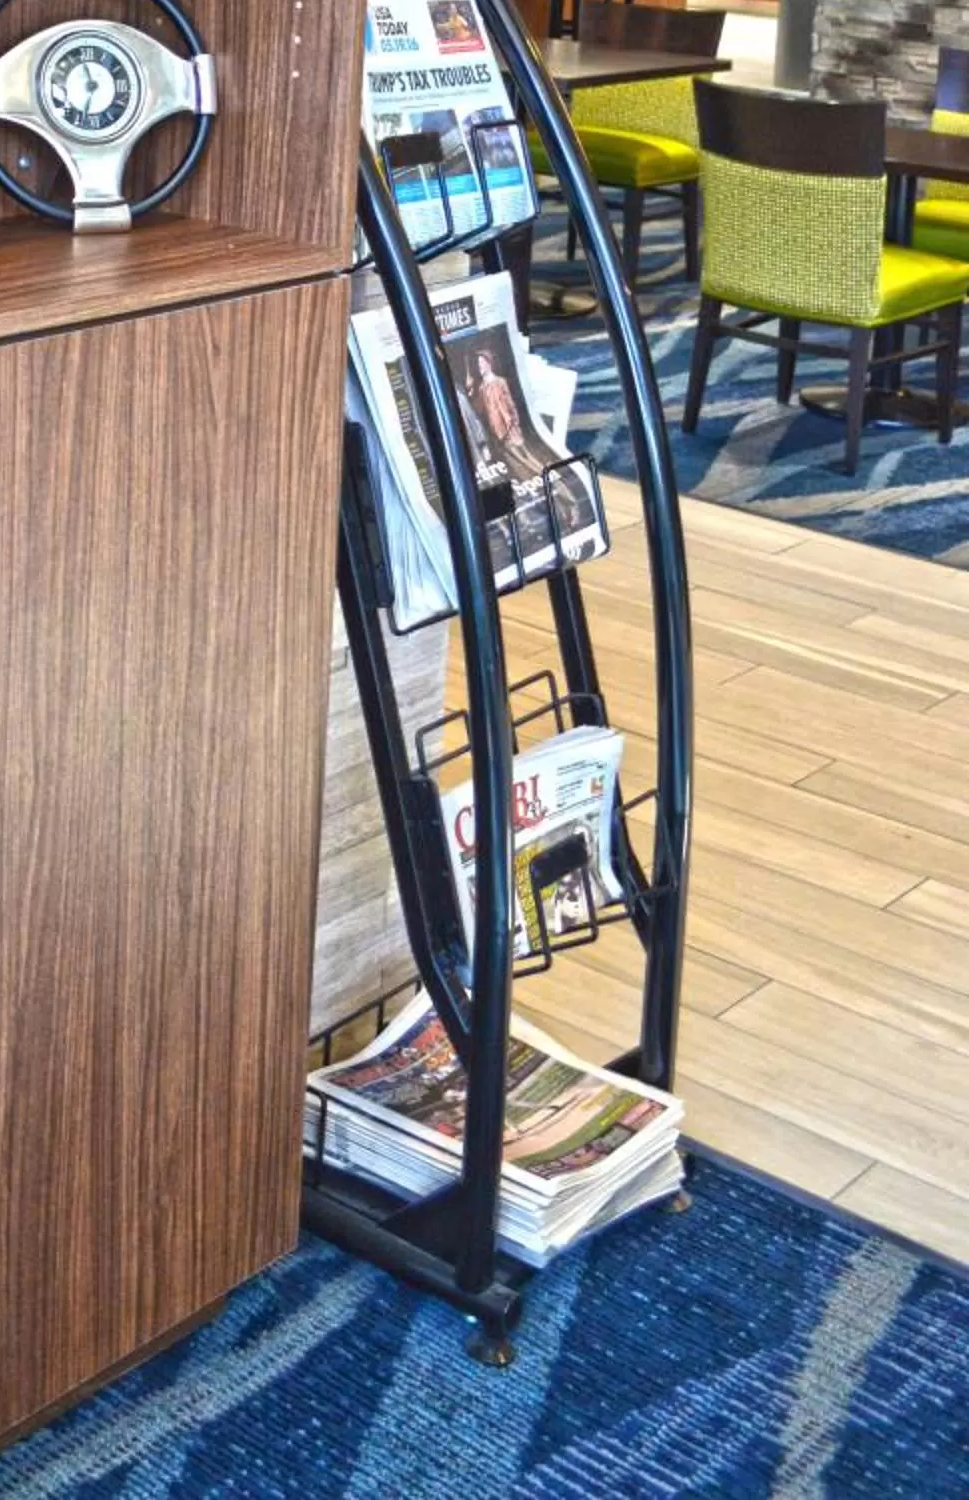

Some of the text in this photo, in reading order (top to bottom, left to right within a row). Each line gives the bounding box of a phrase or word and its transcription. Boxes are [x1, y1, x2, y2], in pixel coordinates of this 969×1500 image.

[376, 21, 408, 37] TODAY
[406, 69, 431, 91] TAX
[429, 63, 492, 89] TROUBLES
